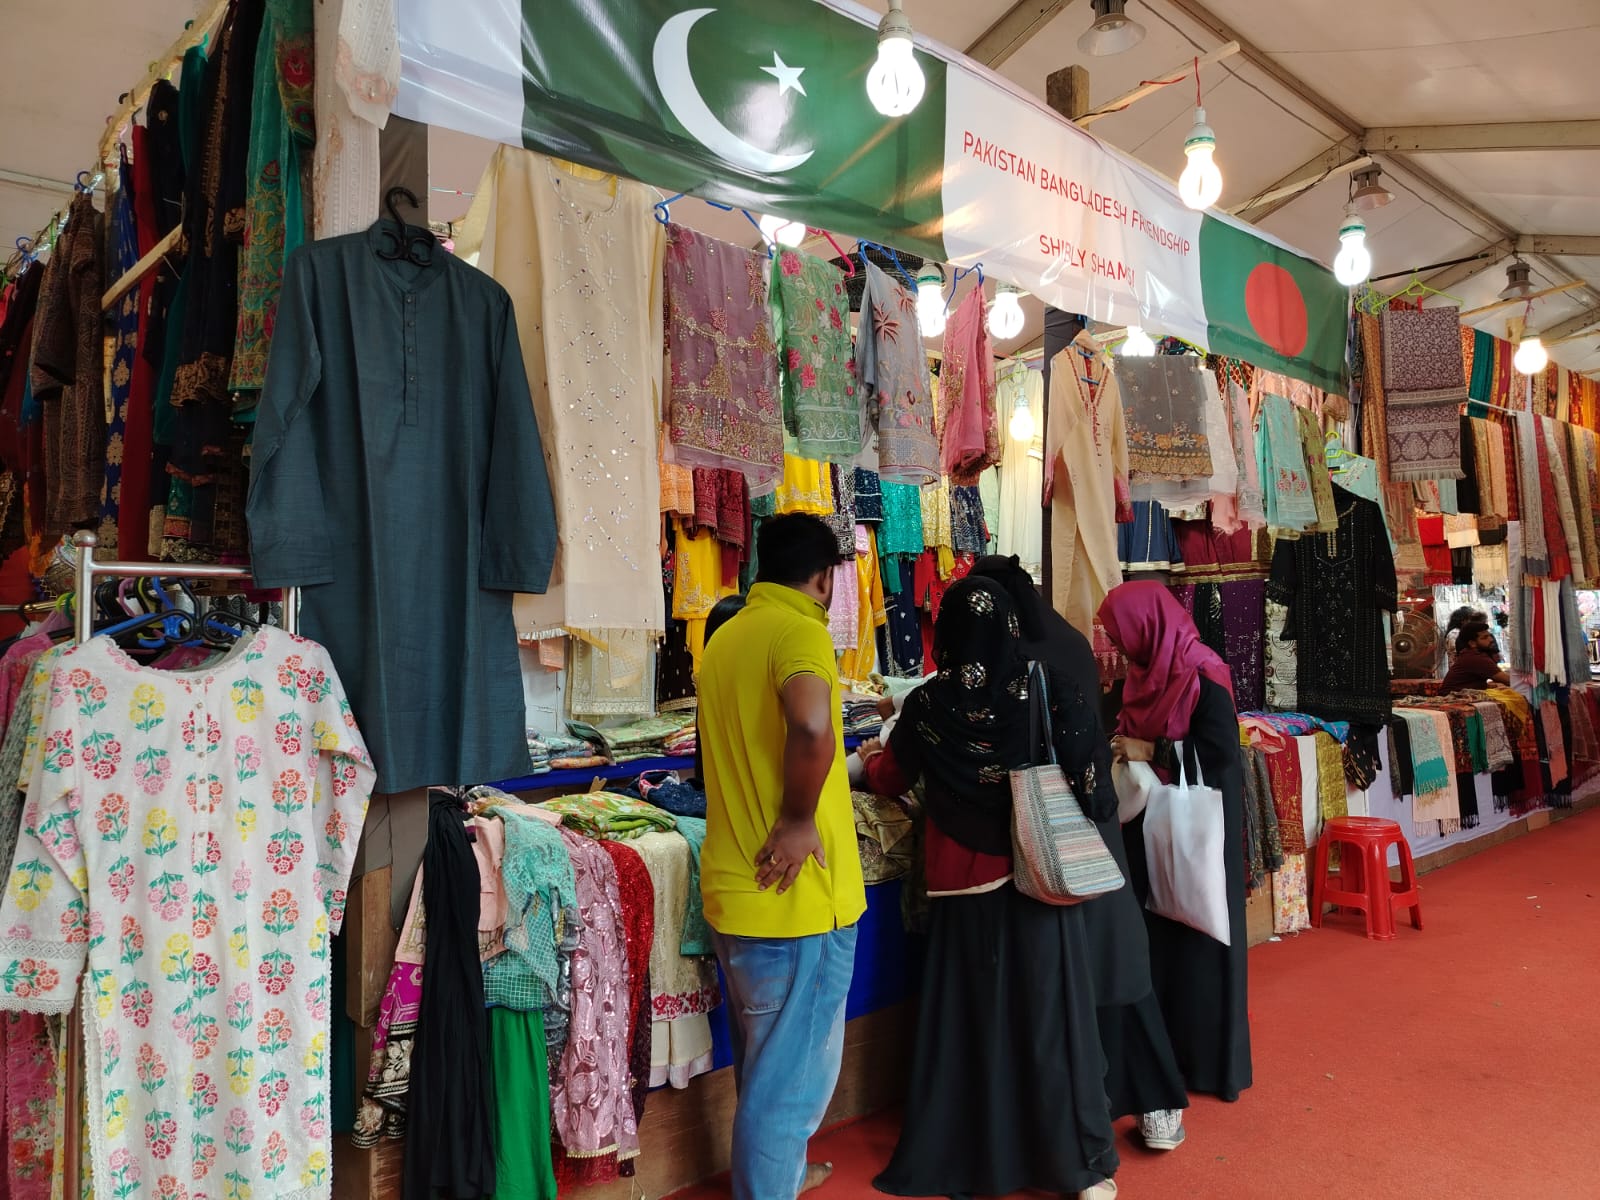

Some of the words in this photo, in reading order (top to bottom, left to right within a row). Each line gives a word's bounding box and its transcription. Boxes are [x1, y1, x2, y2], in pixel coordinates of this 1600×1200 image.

[965, 132, 1035, 184] PAKISTAN
[1041, 169, 1126, 224] BANGLADESH
[1133, 211, 1190, 256] FRIENDSHIP
